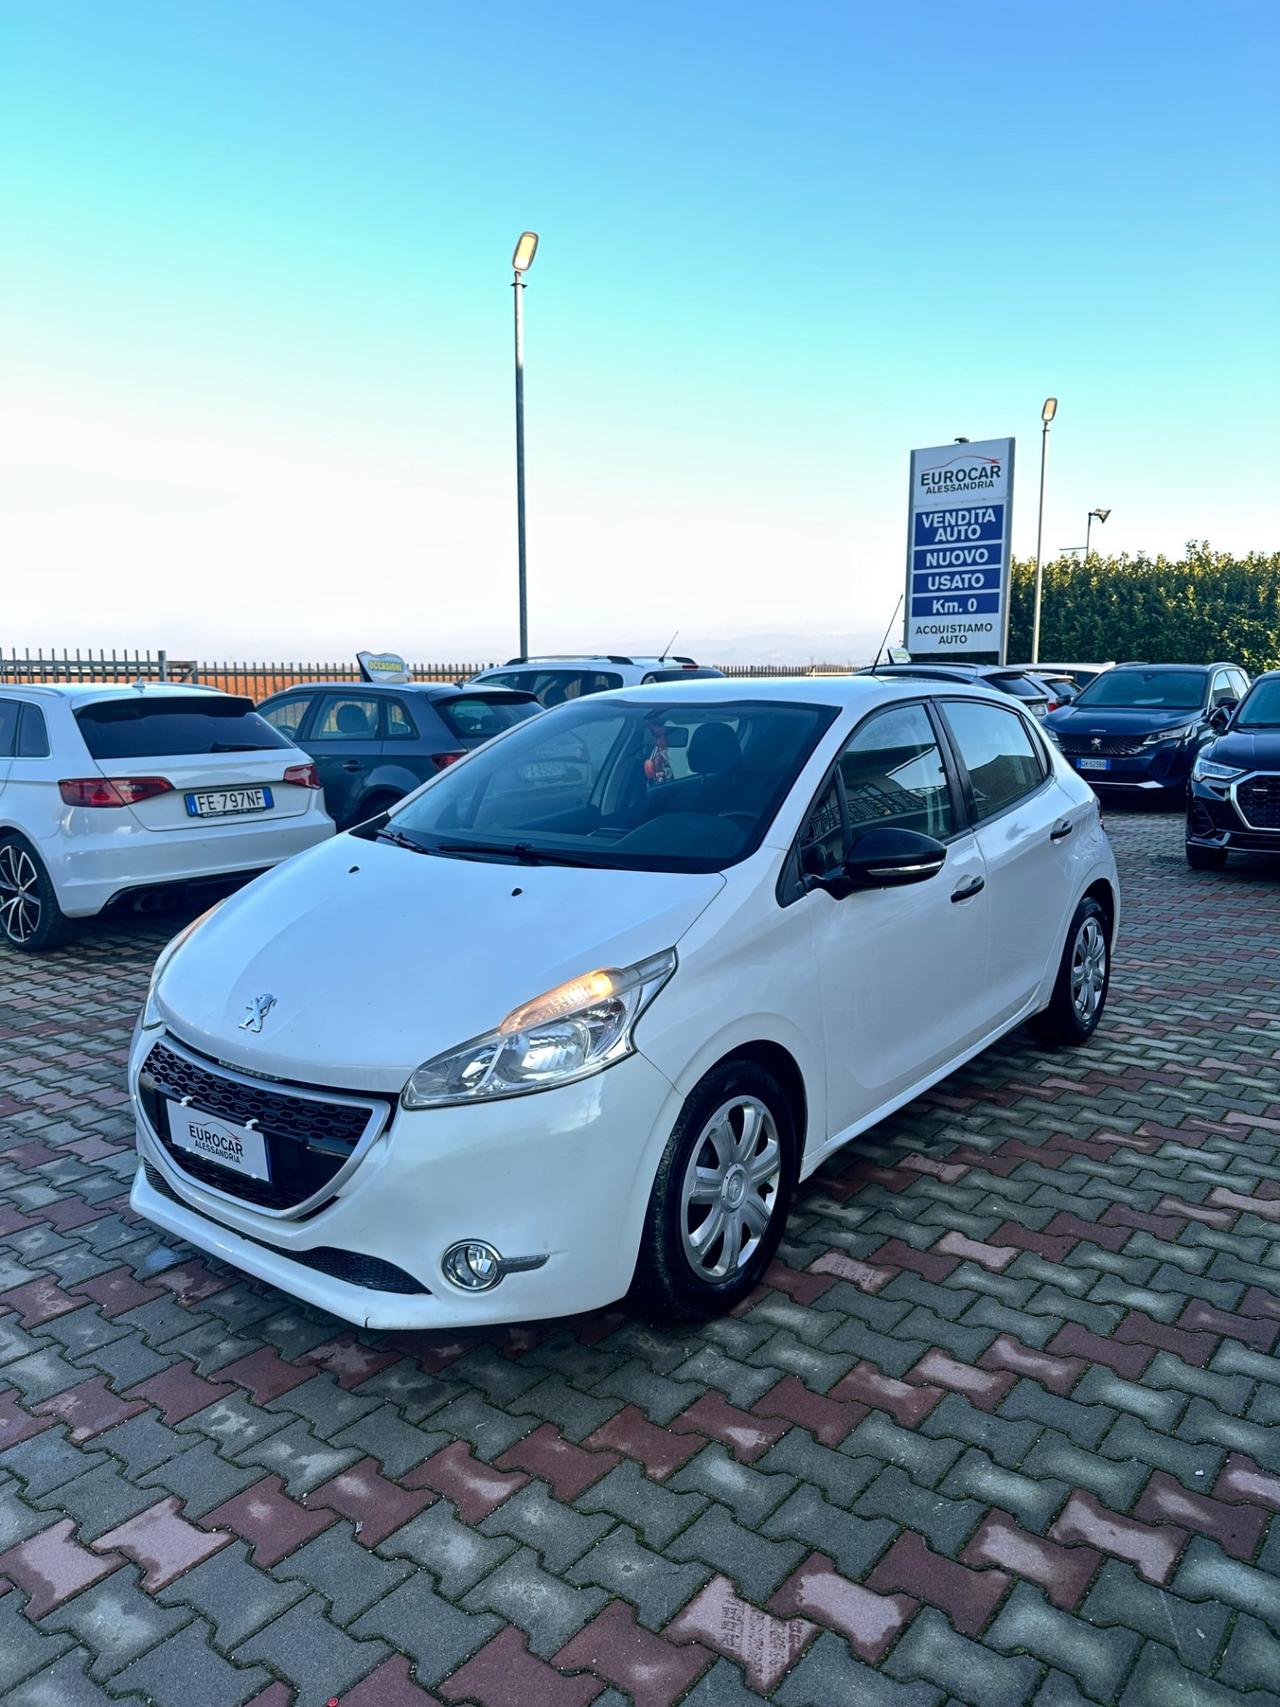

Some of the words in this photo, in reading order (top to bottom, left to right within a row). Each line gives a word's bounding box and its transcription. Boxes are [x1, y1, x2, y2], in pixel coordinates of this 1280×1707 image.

[921, 465, 1001, 487] EUROCAR
[925, 480, 995, 495] ALESSANDRIA
[922, 508, 996, 528] VENDITA
[934, 524, 981, 542] AUTO
[926, 548, 989, 567] NUOVO
[928, 573, 985, 590] USATO
[932, 599, 963, 614] Km.
[967, 598, 977, 612] 0
[915, 622, 993, 635] ACQUISTIAMO
[938, 634, 968, 645] AUTO
[189, 1124, 243, 1157] EUROCAR
[194, 1139, 241, 1164] ALESSANDRIA
